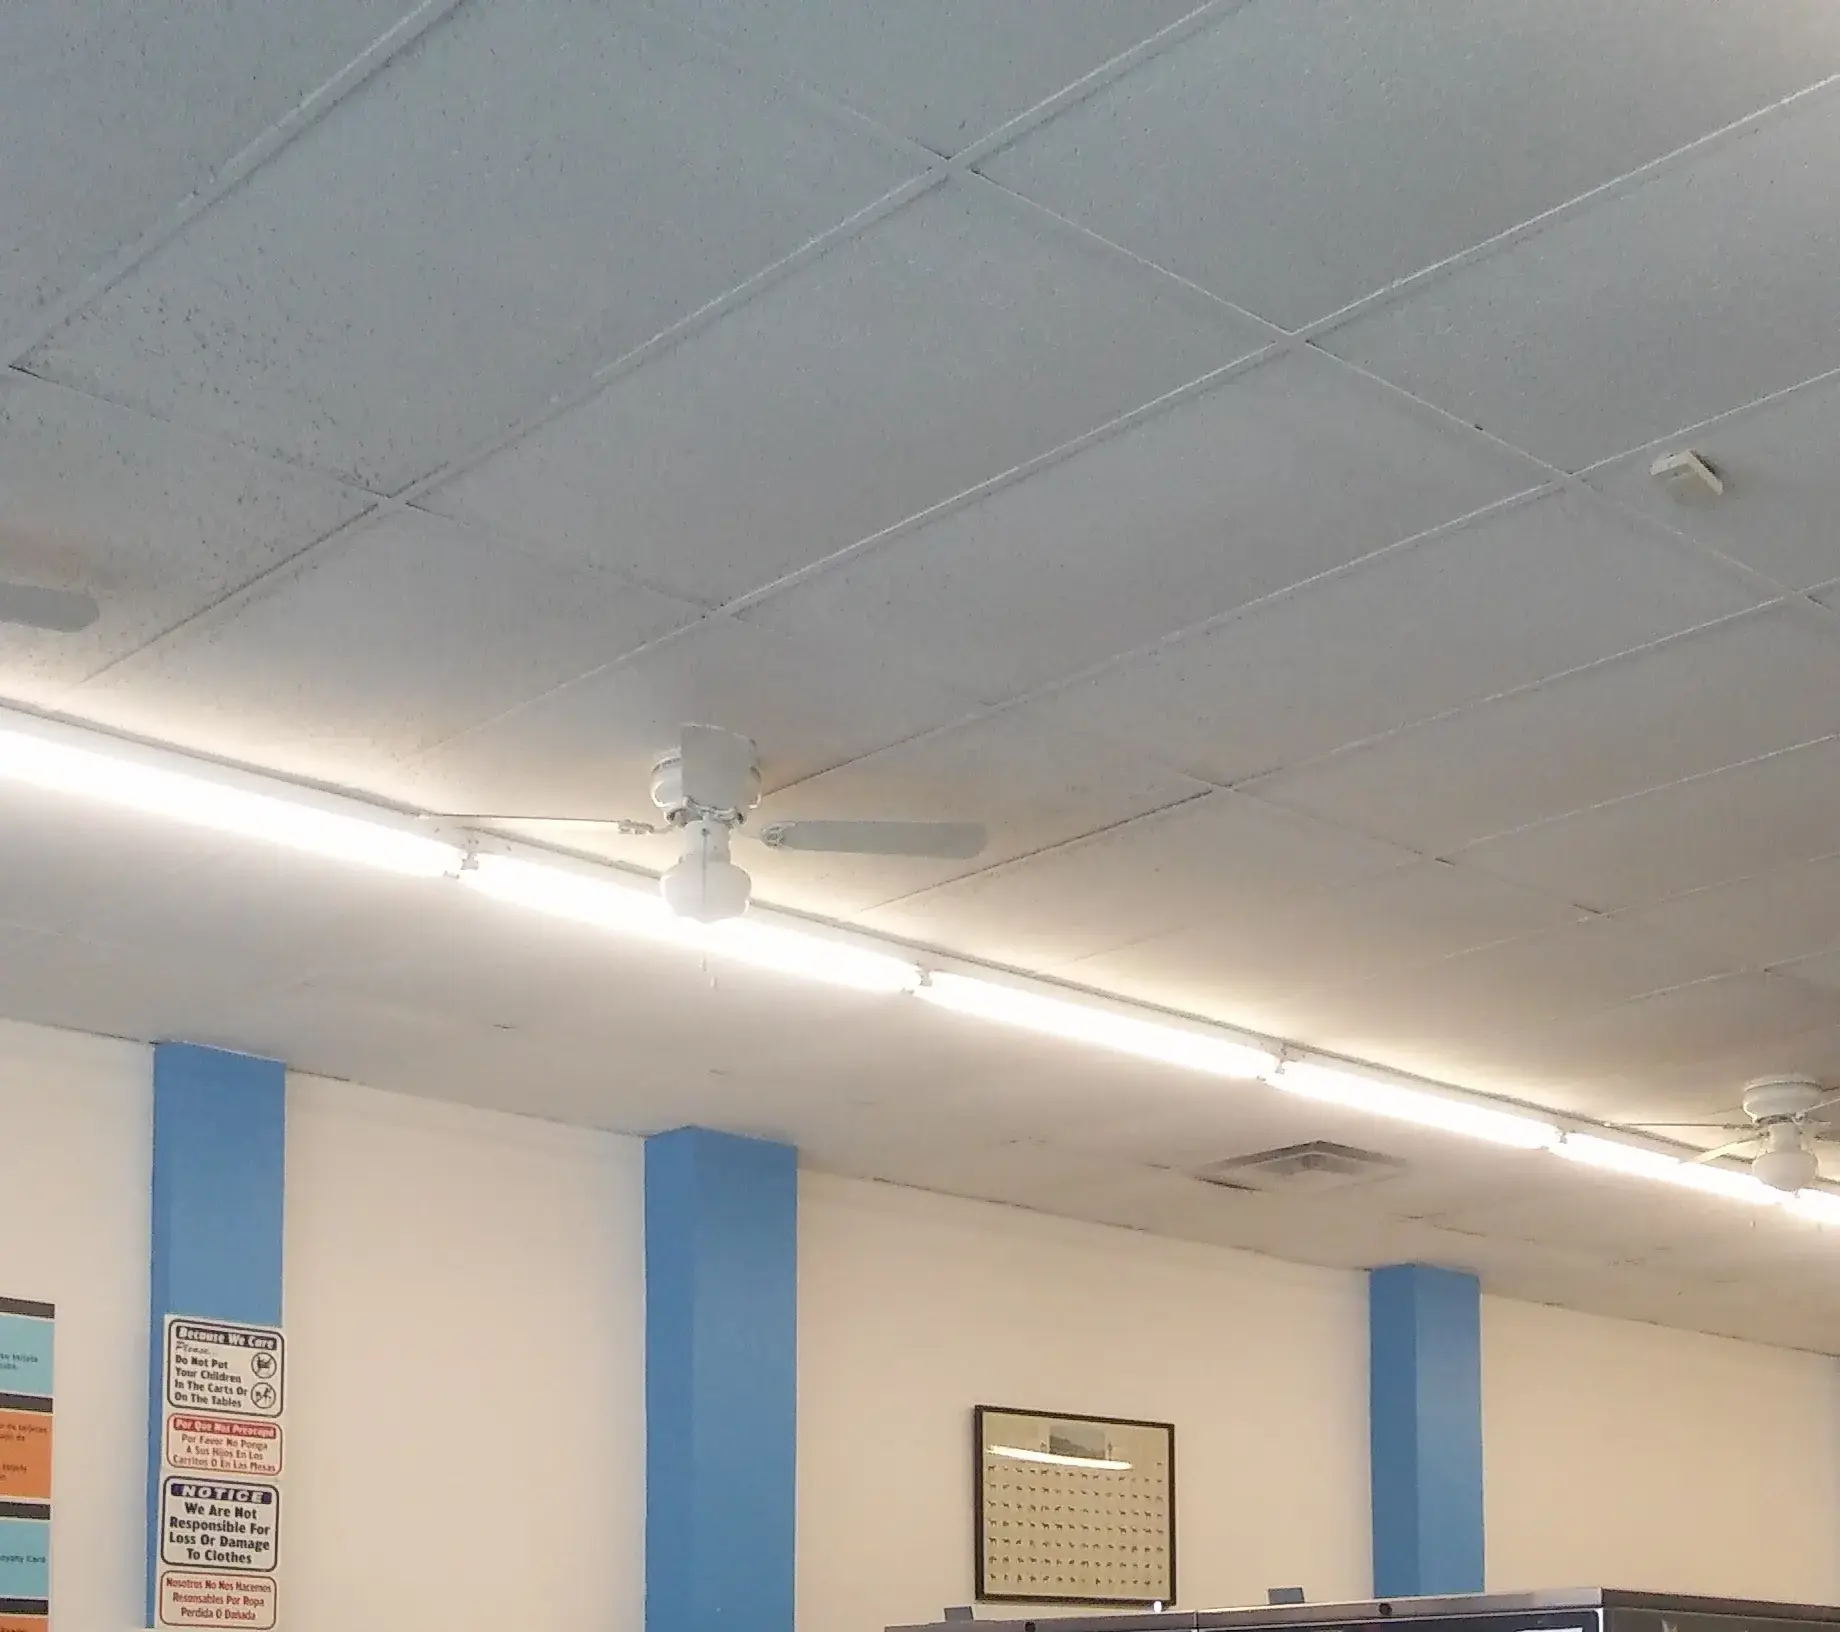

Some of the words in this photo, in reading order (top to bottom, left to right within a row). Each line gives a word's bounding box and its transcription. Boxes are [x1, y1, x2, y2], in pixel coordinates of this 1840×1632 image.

[179, 1327, 225, 1343] Because
[229, 1334, 245, 1345] We
[247, 1335, 275, 1349] Care
[176, 1355, 188, 1364] Do
[191, 1356, 208, 1367] Not
[212, 1359, 228, 1369] Put
[175, 1368, 196, 1378] Your
[201, 1370, 241, 1383] Children
[175, 1379, 184, 1389] In
[188, 1381, 204, 1391] The
[208, 1383, 233, 1394] Carts
[236, 1387, 247, 1396] Or
[175, 1392, 188, 1402] On
[191, 1394, 208, 1404] The
[212, 1396, 241, 1407] Tables
[182, 1434, 195, 1442] Por
[200, 1435, 222, 1445] Favor
[227, 1438, 238, 1447] No
[241, 1439, 267, 1450] Ponga
[173, 1455, 208, 1467] Carritos
[212, 1459, 217, 1467] O
[221, 1460, 230, 1468] En
[234, 1461, 247, 1469] Las
[250, 1462, 275, 1472] Mesas
[182, 1486, 264, 1503] NOTICE
[184, 1503, 204, 1515] We
[209, 1504, 230, 1517] Are
[235, 1507, 257, 1519] Not
[170, 1517, 246, 1534] Responsible
[250, 1524, 270, 1535] For
[170, 1532, 196, 1544] Loss
[201, 1535, 216, 1546] Or
[220, 1536, 270, 1552] Damage
[187, 1549, 200, 1561] To
[205, 1550, 252, 1564] Clothes
[166, 1578, 202, 1589] Nosotros
[206, 1581, 216, 1589] No
[219, 1581, 233, 1591] Nos
[236, 1582, 271, 1592] Hacemos
[227, 1596, 240, 1605] Por
[244, 1596, 264, 1608] Ropa
[181, 1608, 213, 1618] Perdida
[216, 1610, 222, 1618] O
